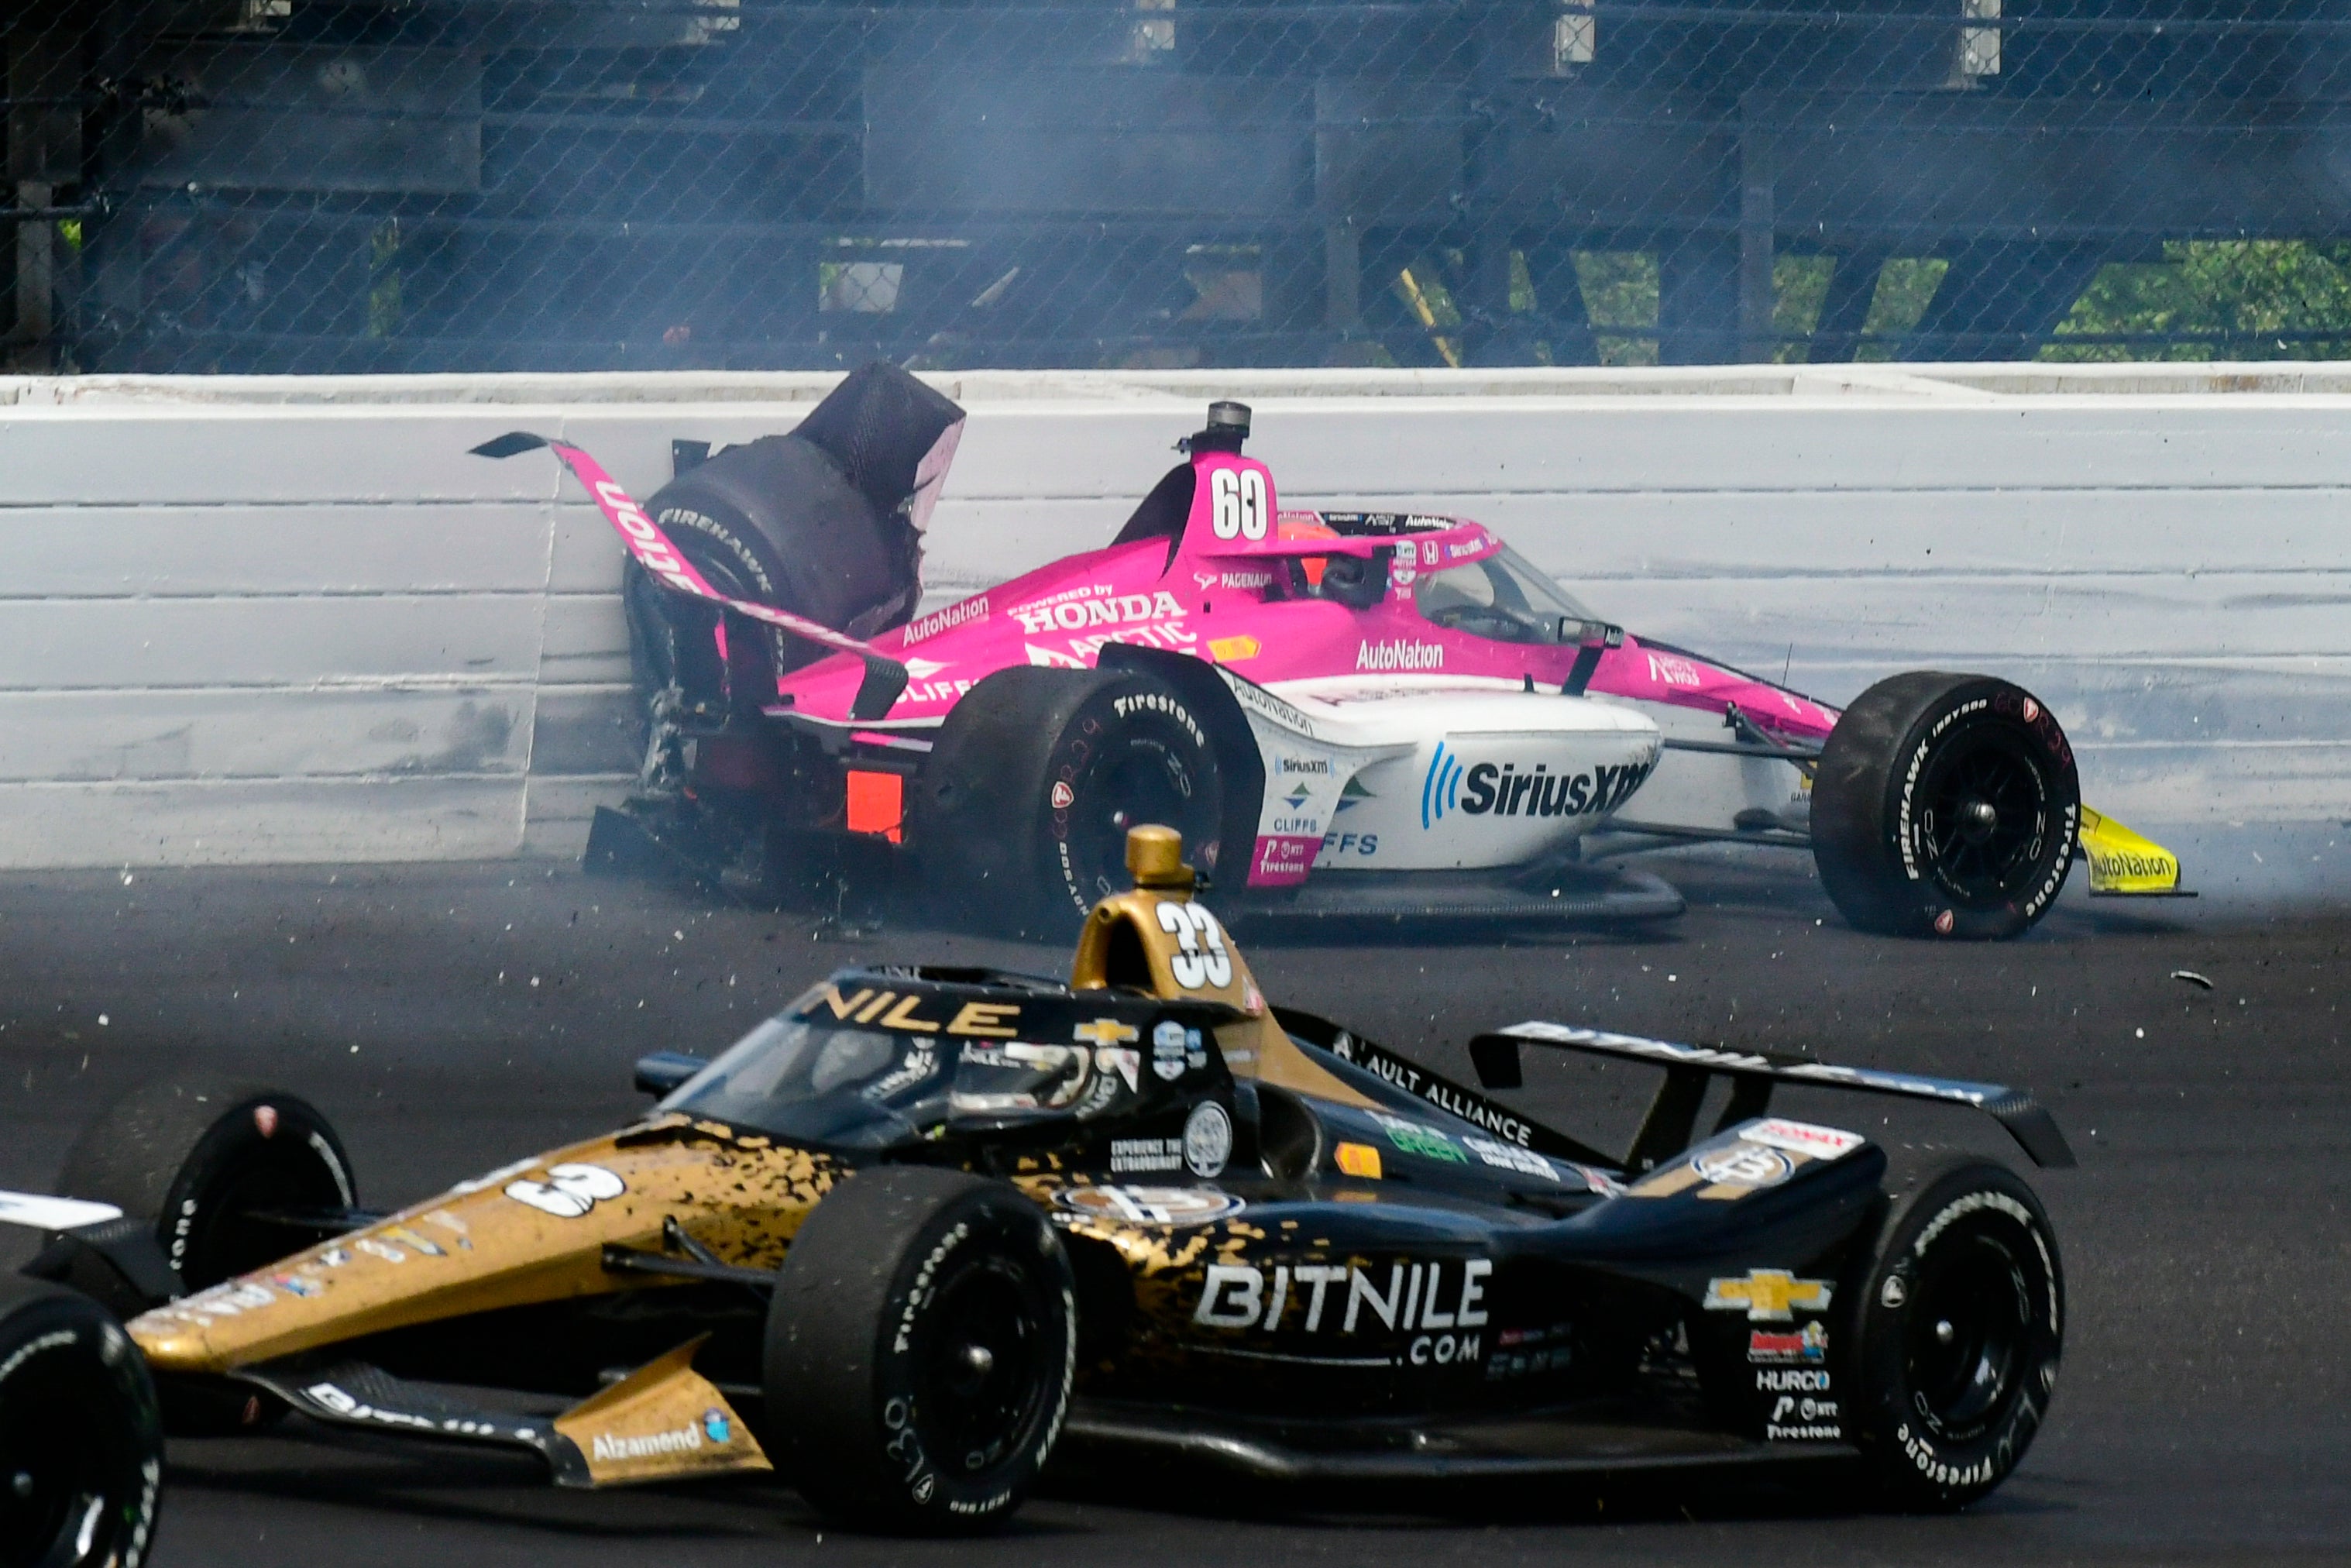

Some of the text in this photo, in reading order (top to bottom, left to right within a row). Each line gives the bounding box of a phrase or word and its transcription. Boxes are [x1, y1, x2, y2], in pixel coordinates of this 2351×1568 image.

[1211, 468, 1267, 541] 60
[902, 596, 989, 648] AutoNation
[1008, 583, 1113, 617] POWERED by
[1013, 590, 1188, 634] HONDA
[1356, 638, 1444, 670] AutoNation
[895, 678, 981, 704] LIFF
[1232, 674, 1314, 737] AutoNation
[1113, 693, 1205, 748] Firestone
[1461, 762, 1650, 817] SiriusXM
[1899, 738, 1930, 880] FIREHAWK
[1260, 859, 1304, 875] Firestone
[2025, 803, 2077, 917] Firestone
[1156, 901, 1233, 989] 33
[1366, 1054, 1421, 1092] AULT
[1425, 1082, 1532, 1149] ALLIANCE
[1194, 1258, 1493, 1333] BITNILE
[1755, 1369, 1830, 1391] HURCO
[1766, 1423, 1841, 1442] Firestone
[1897, 1421, 1996, 1486] Firestone
